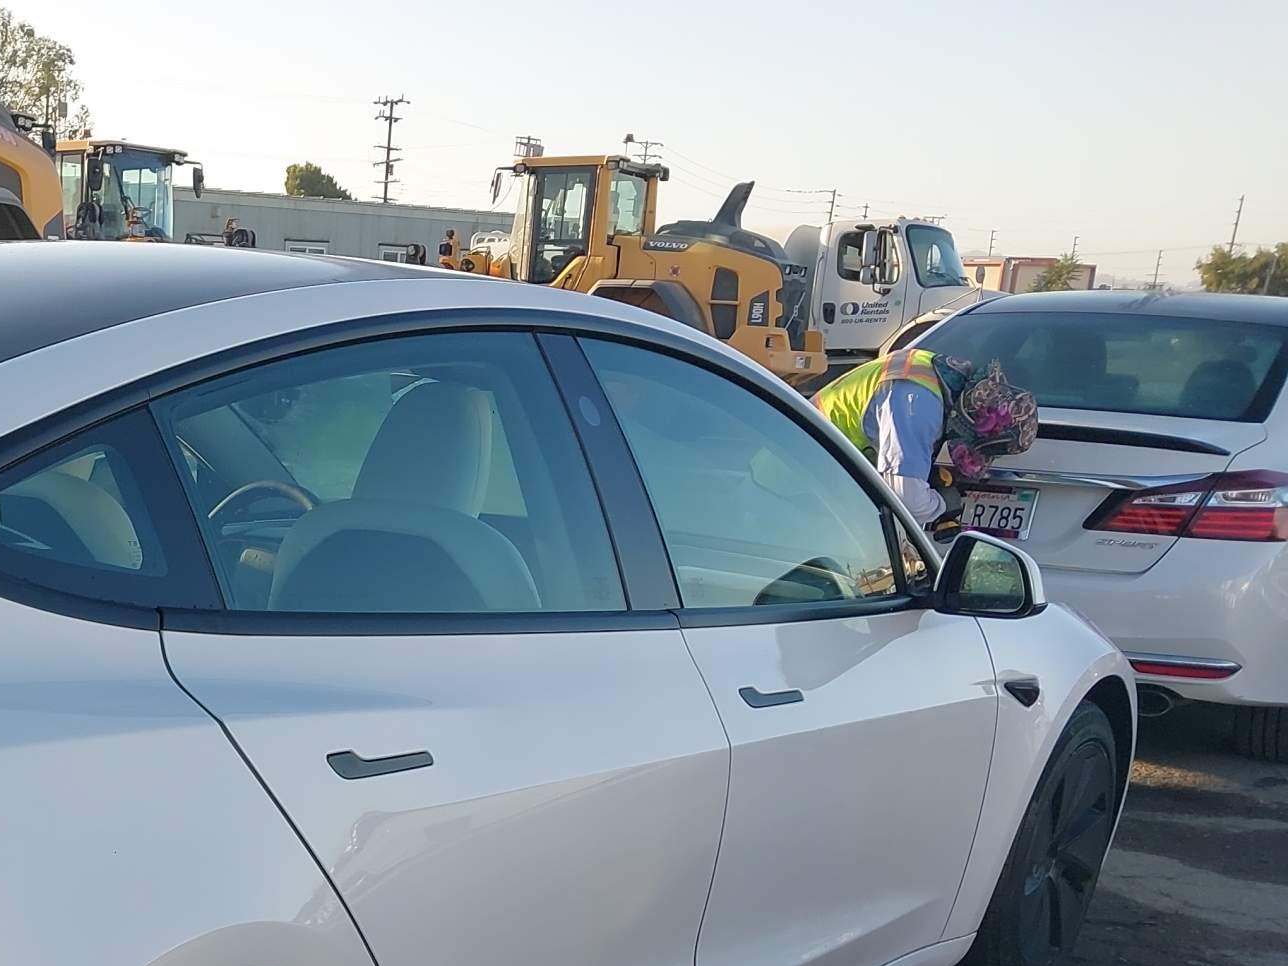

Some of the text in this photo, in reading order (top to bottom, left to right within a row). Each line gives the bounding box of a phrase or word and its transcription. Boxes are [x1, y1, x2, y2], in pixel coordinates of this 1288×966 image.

[649, 240, 689, 250] VOLVO
[861, 301, 889, 309] United
[750, 302, 765, 323] L90H
[860, 308, 890, 316] Rentals
